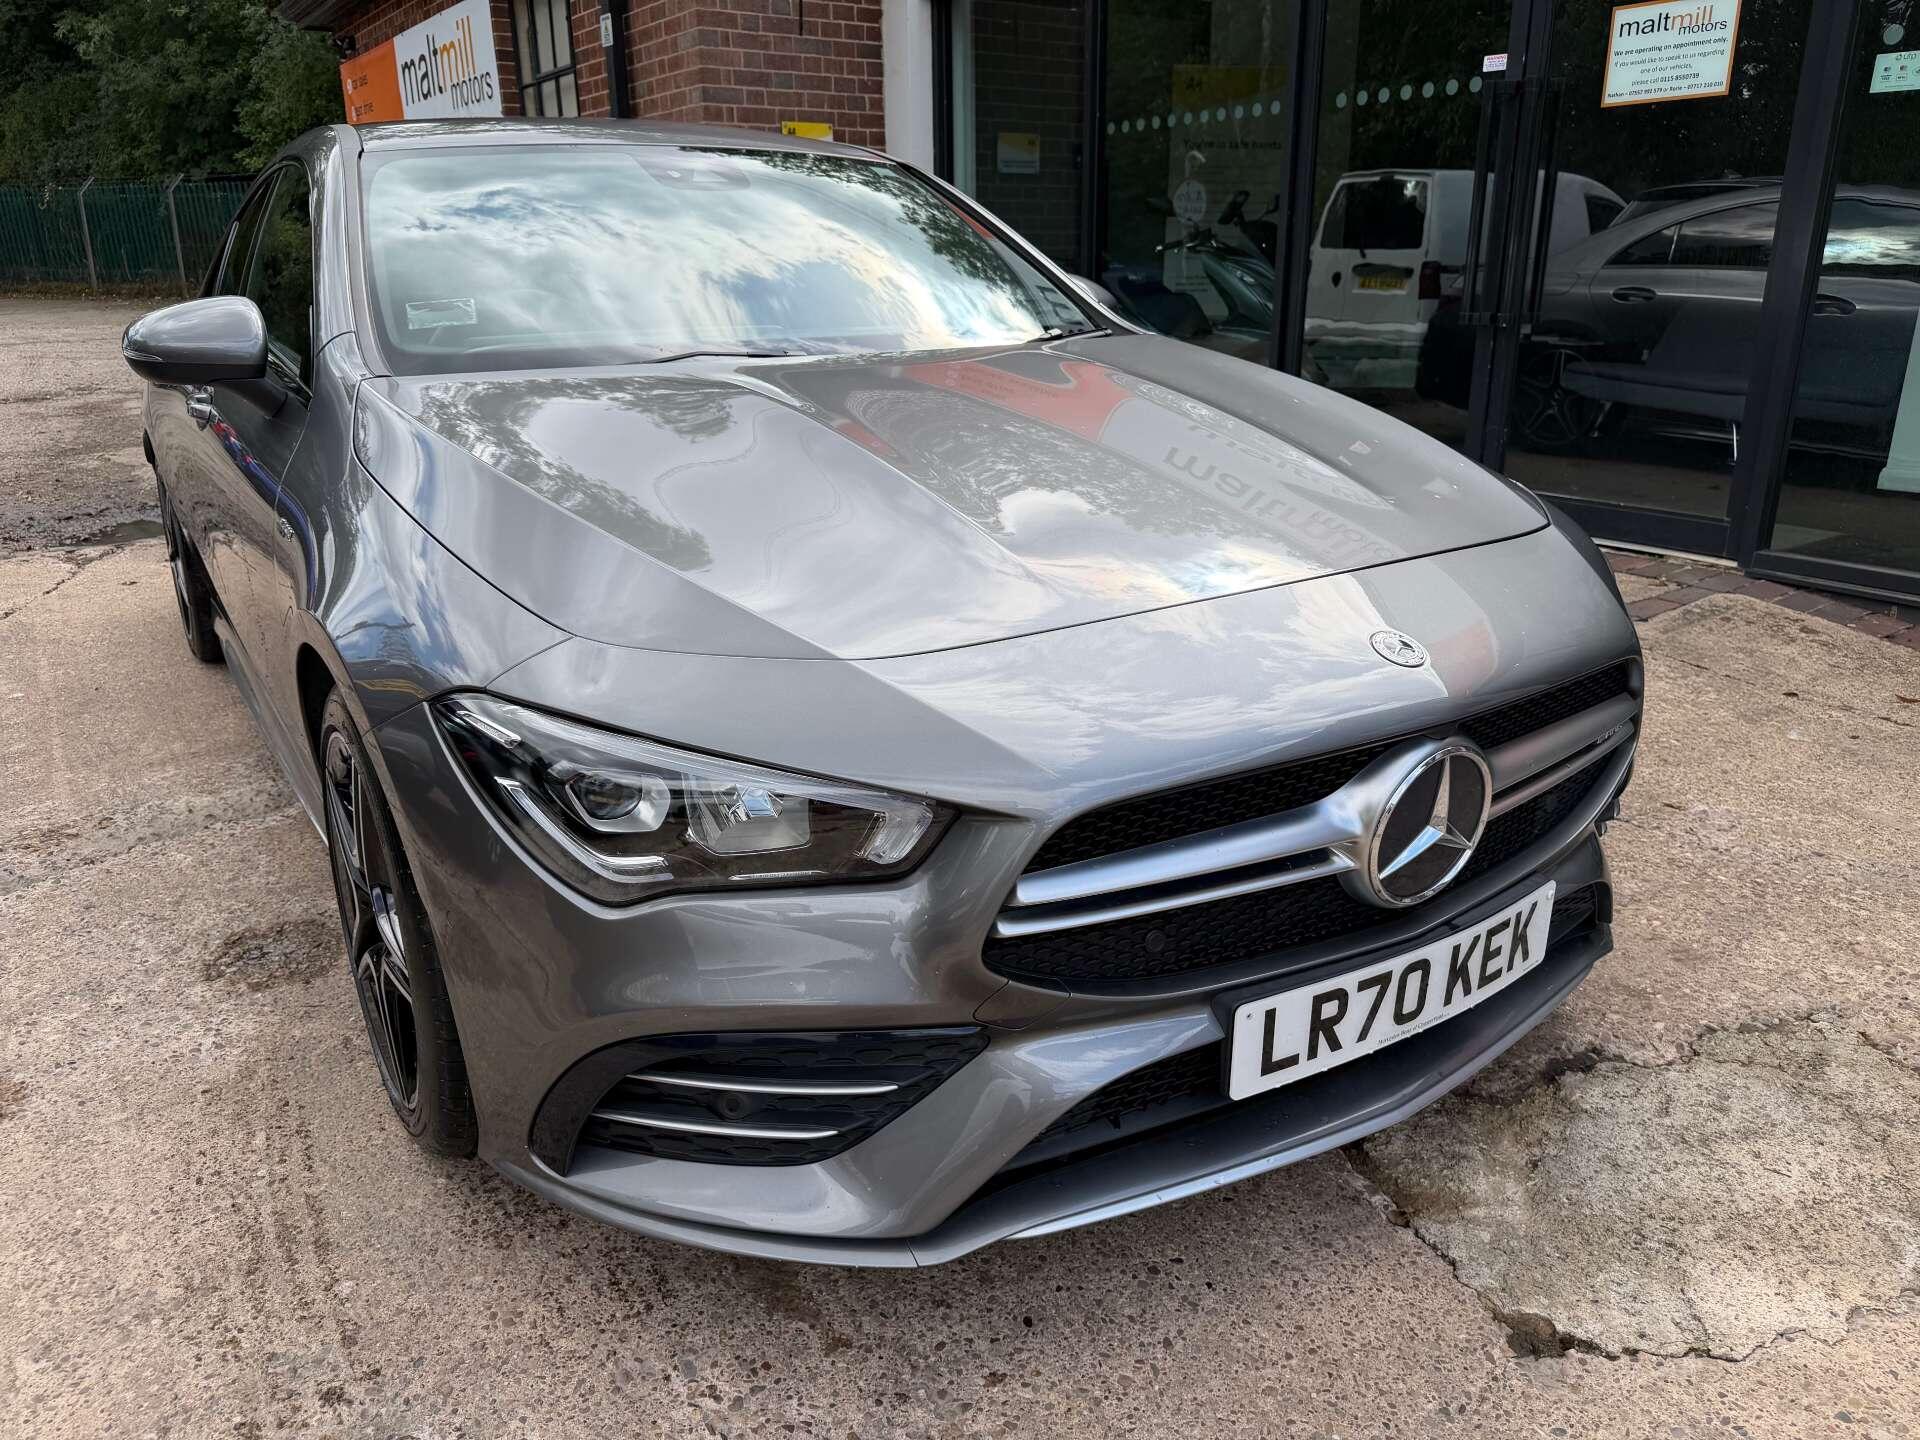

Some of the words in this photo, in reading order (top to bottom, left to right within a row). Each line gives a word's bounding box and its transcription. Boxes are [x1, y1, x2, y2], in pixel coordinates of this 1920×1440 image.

[1619, 4, 1714, 37] maltmill
[1678, 20, 1728, 36] motors
[1634, 45, 1663, 55] operating
[1672, 38, 1712, 49] appointment
[401, 15, 476, 106] maltmill
[1619, 60, 1629, 68] you
[1629, 57, 1647, 66] would
[1647, 56, 1657, 64] like
[1697, 48, 1725, 58] regarding
[1651, 65, 1658, 73] of
[450, 71, 494, 110] motors
[1631, 78, 1649, 87] please
[1649, 76, 1660, 84] call
[1260, 958, 1432, 1077] LR70
[1443, 901, 1538, 1007] KEK
